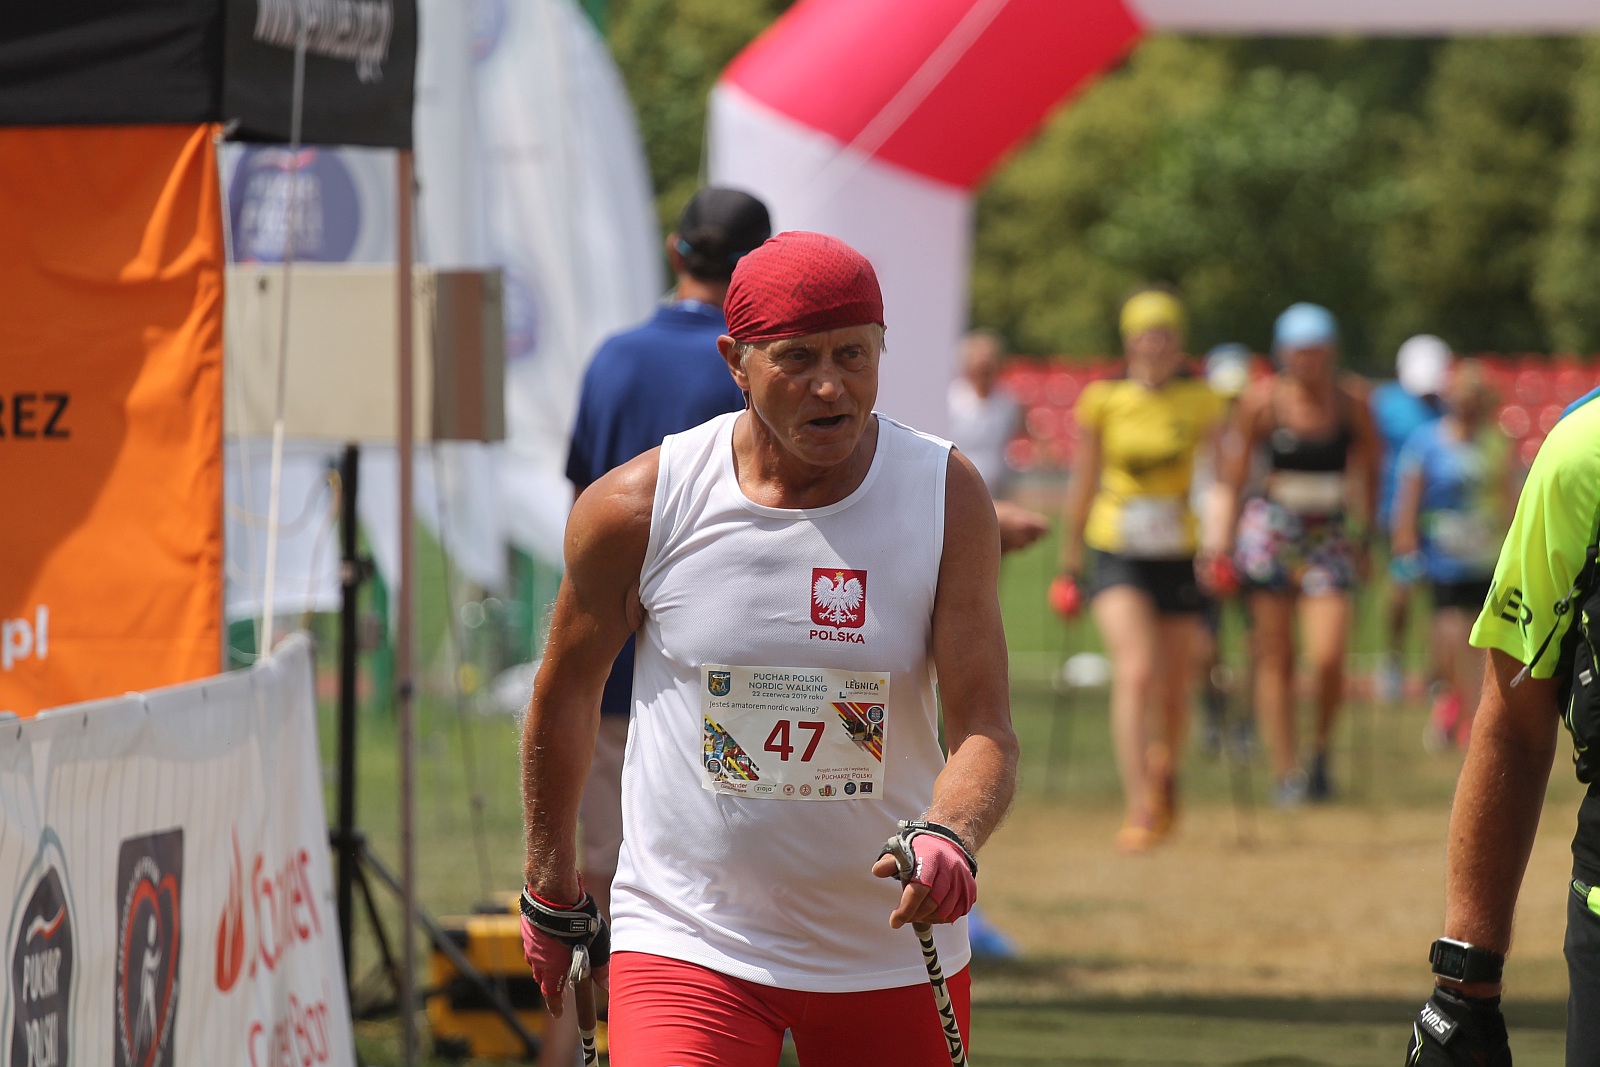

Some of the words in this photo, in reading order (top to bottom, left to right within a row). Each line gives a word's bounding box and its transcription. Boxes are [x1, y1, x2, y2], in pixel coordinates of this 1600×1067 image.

[809, 629, 866, 644] POLSKA
[753, 672, 790, 682] PUCHAR
[792, 674, 823, 683] POLSKI
[748, 682, 784, 691] NORDIC
[785, 683, 828, 692] WALKING
[762, 691, 790, 699] czerwca
[791, 692, 807, 700] 2019
[709, 700, 730, 708] Jesteś
[731, 702, 767, 710] amatorem
[767, 704, 789, 712] nordic
[790, 704, 820, 714] walking?
[763, 719, 826, 762] 47
